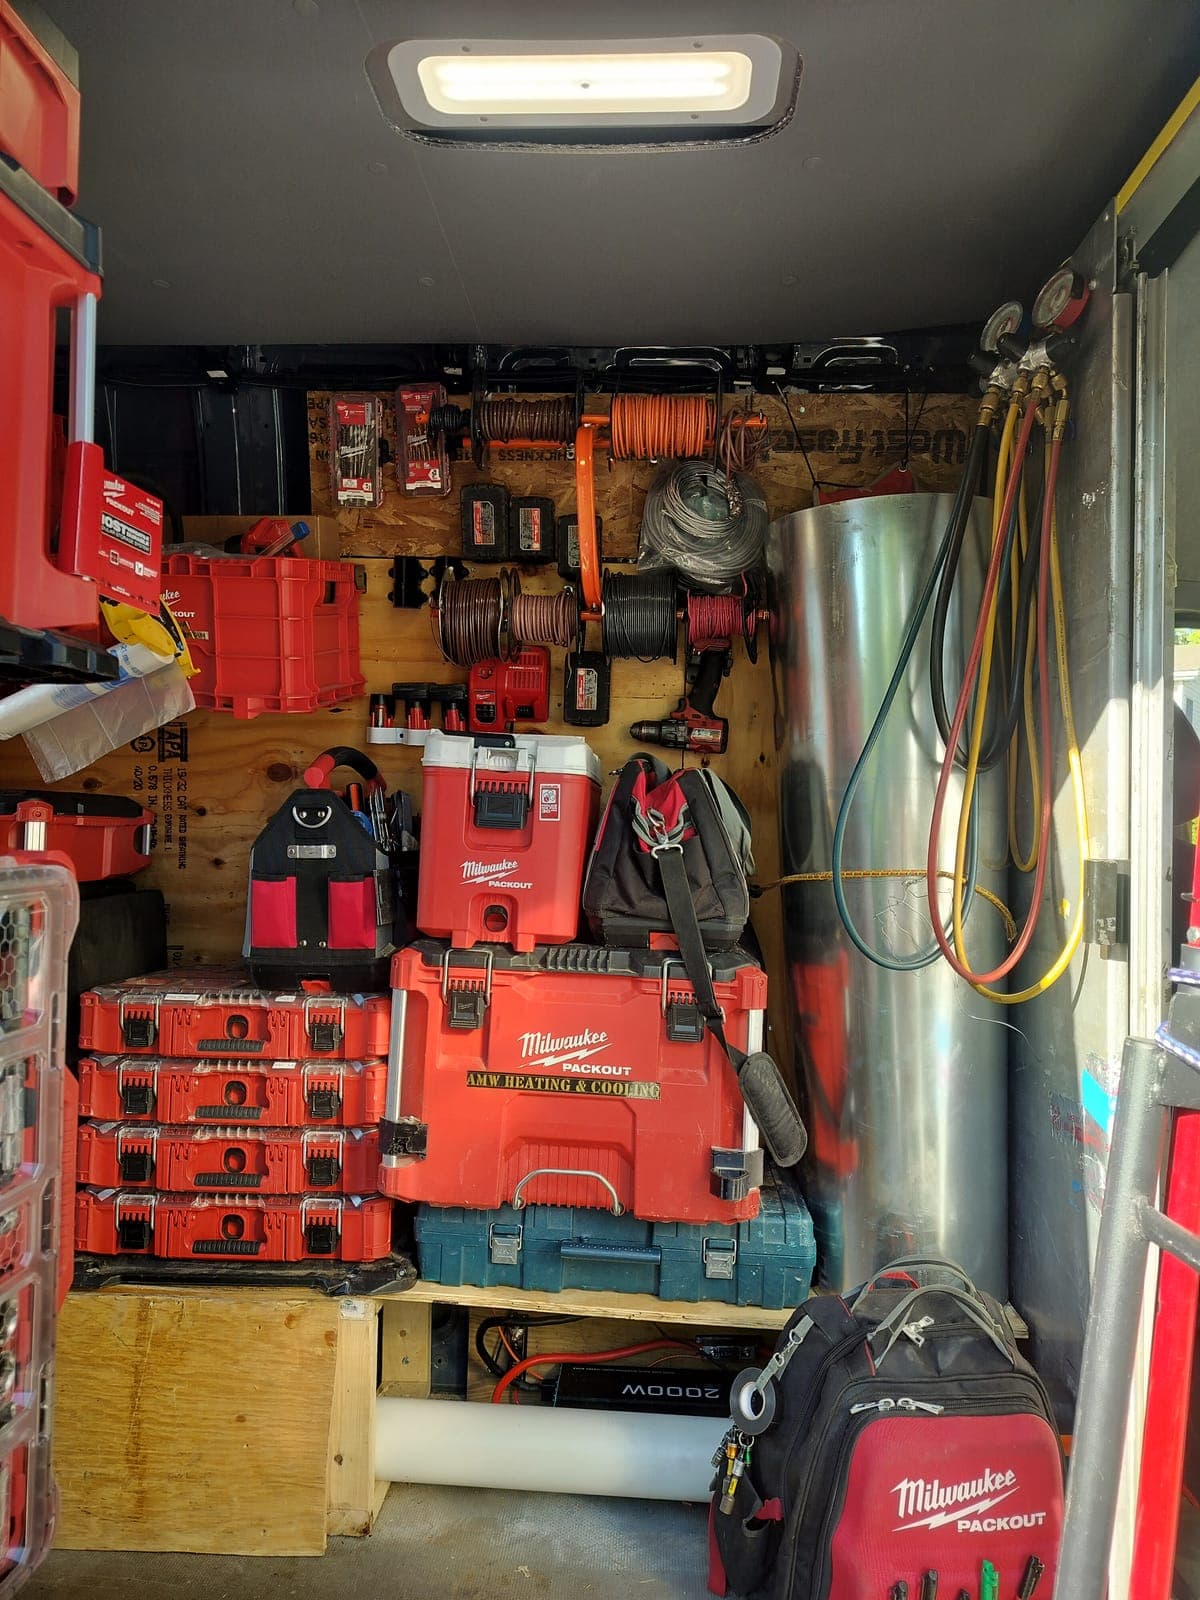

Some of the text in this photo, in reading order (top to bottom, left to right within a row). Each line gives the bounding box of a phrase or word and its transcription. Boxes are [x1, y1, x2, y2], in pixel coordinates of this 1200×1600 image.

[498, 448, 575, 462] HICKNESS
[177, 795, 187, 810] CAT
[460, 859, 518, 878] Milwaukee
[488, 880, 533, 889] PACKOUT
[517, 1028, 608, 1058] Milwaukee
[562, 1063, 632, 1076] PACKOUT
[467, 1072, 660, 1099] AMW HEATING & COOLING
[622, 1384, 720, 1399] 2000W
[889, 1468, 1017, 1519] Milwaukee
[957, 1512, 1047, 1533] PACKOUT
